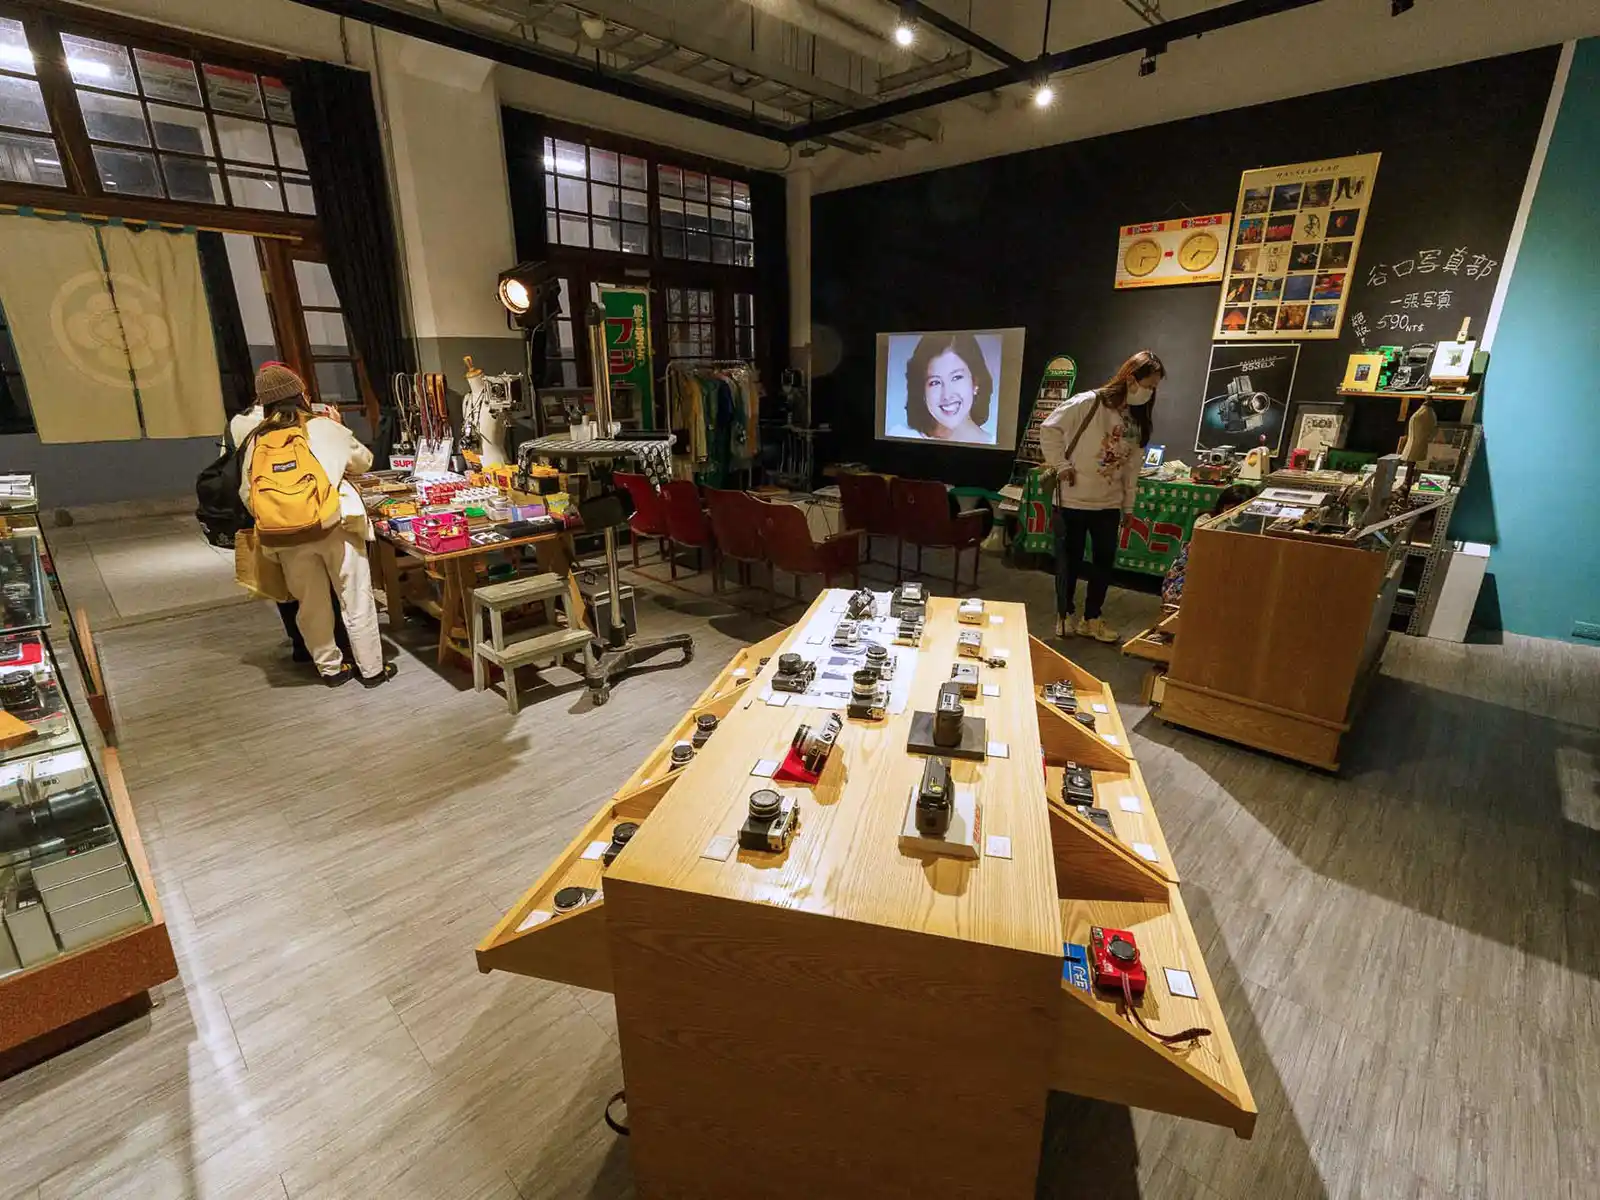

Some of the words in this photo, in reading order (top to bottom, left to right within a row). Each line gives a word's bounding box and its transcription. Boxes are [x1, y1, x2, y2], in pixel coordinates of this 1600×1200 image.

[1367, 247, 1497, 286] 谷口写真部
